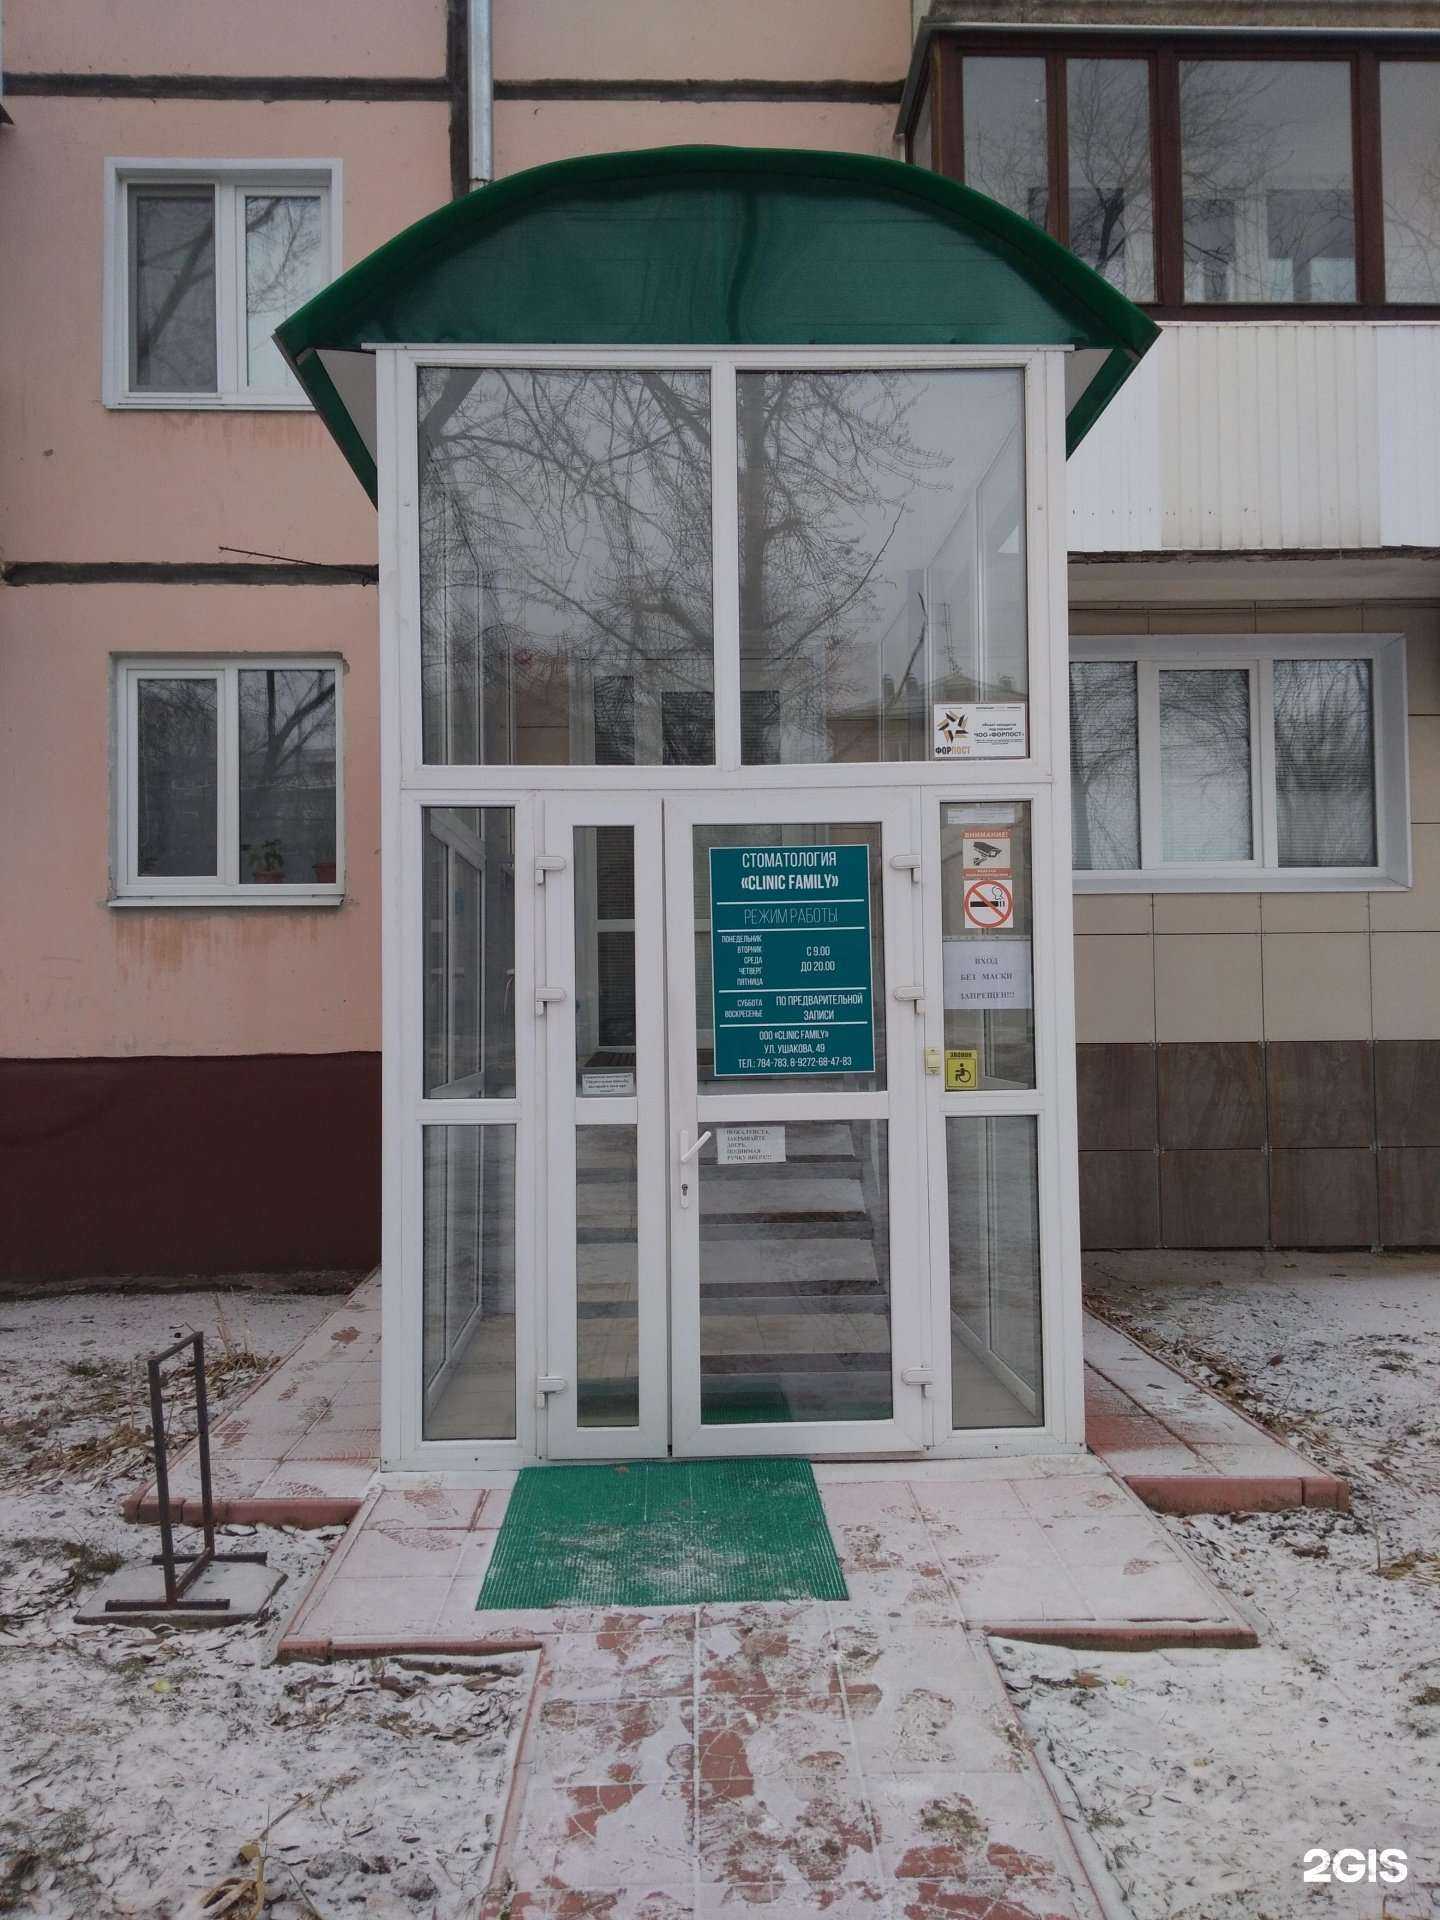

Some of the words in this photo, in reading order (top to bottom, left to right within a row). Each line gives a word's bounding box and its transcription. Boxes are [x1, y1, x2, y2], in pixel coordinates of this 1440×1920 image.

[935, 746, 970, 755] ФОРПОСТ
[742, 851, 837, 868] СТОМАТОЛОГИЯ
[741, 875, 786, 890] «CLINIC
[788, 874, 839, 889] FAMILY»
[744, 908, 788, 925] РЕЖИМ
[790, 907, 838, 923] РАБОТЫ
[721, 935, 763, 943] ПОНЕДЕЛЬНИК
[737, 945, 762, 953] ВТОРНИК
[806, 946, 812, 956] С
[812, 945, 831, 956] 9.00
[743, 956, 763, 964] СРЕДА
[738, 967, 762, 975] ЧЕТВЕРГ
[800, 961, 812, 973] ДО
[813, 960, 836, 972] 20.00
[982, 972, 1013, 980] МАСКИ
[736, 978, 763, 986] ПЯТНИЦА
[737, 999, 763, 1007] СУББОТА
[776, 995, 787, 1006] ПО
[787, 992, 864, 1006] ПРЕДВАРИТЕЛЬНОЙ
[724, 1010, 763, 1018] ВОСКРЕСЕНЬЕ
[803, 1009, 835, 1021] ЗАПИСИ
[759, 1030, 773, 1041] ООО
[774, 1029, 800, 1040] «CLINIC
[800, 1029, 829, 1040] FAMILY»
[815, 1043, 825, 1053] 49
[757, 1058, 790, 1068] 784-783,
[790, 1056, 852, 1068] 8-9272-68-47-83
